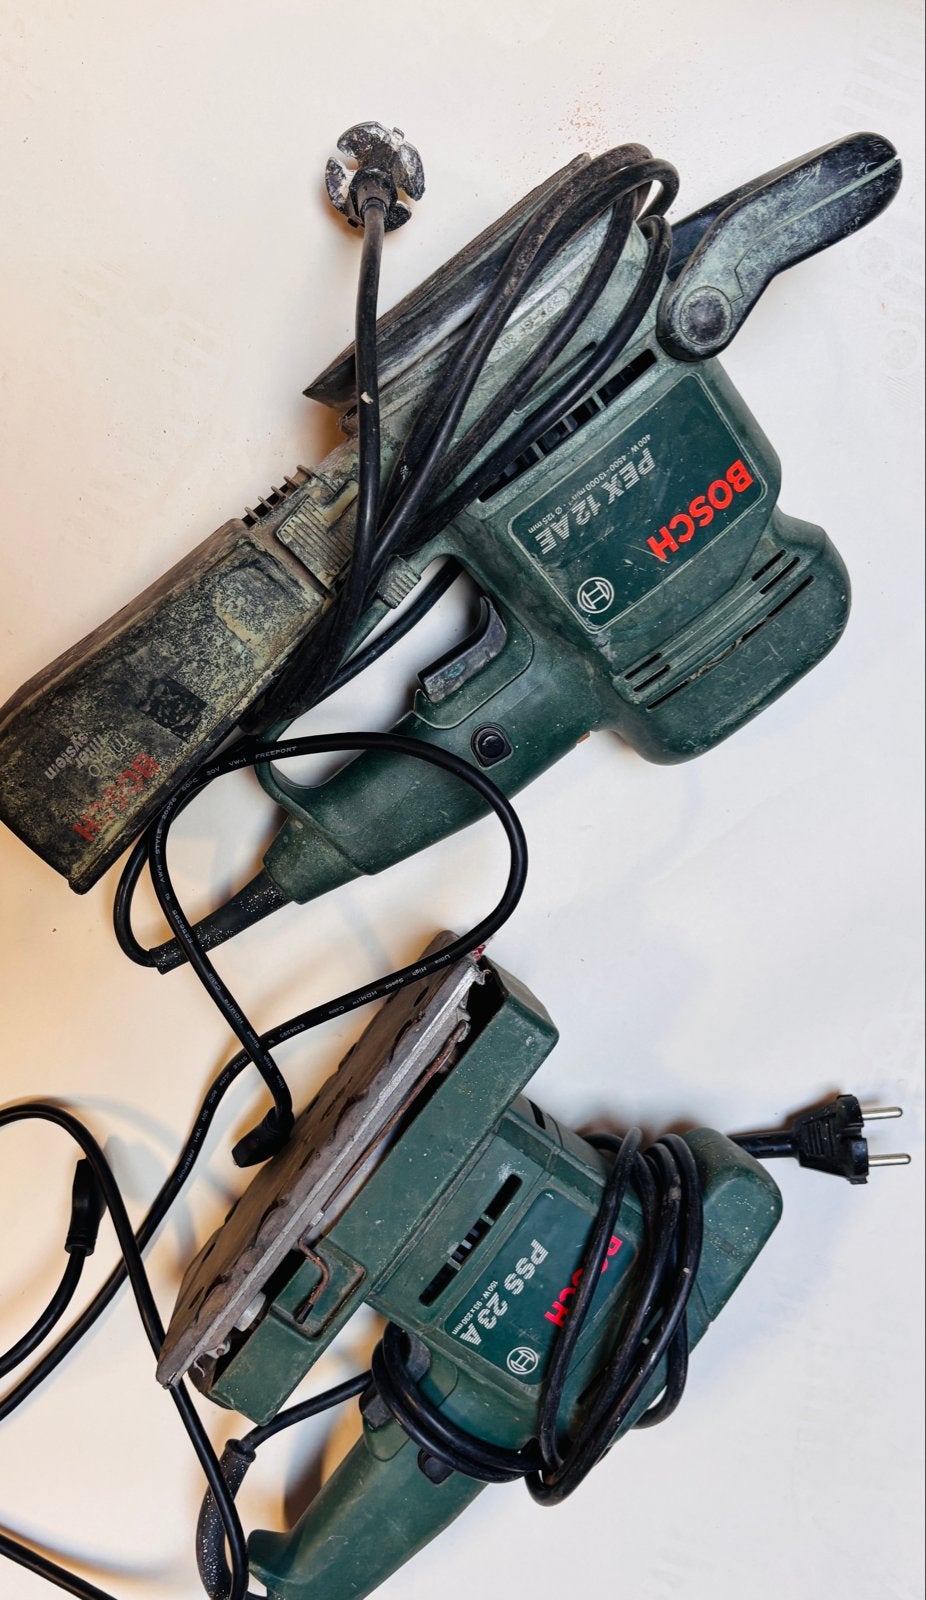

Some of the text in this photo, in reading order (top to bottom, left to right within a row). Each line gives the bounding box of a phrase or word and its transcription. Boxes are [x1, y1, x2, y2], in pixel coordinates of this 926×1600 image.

[637, 434, 651, 447] 400
[630, 444, 640, 455] W
[535, 447, 656, 555] PEX 12 AE
[646, 459, 754, 562] BOSCH
[542, 512, 555, 525] 125
[528, 521, 543, 534] mm
[44, 732, 88, 780] system
[255, 745, 298, 760] FREEPORT
[228, 757, 247, 767] VW-1
[206, 766, 220, 776] 30V
[72, 752, 159, 842] BOSCH
[155, 827, 163, 855] STYLE
[157, 864, 166, 883] AWM
[411, 965, 428, 976] High
[384, 977, 405, 991] Speed
[487, 1280, 498, 1292] 150
[544, 1235, 623, 1328] BCH
[459, 1239, 549, 1346] PSS 23 A
[482, 1290, 492, 1300] W
[473, 1300, 483, 1311] 93
[461, 1311, 473, 1325] 230
[451, 1322, 464, 1335] mm
